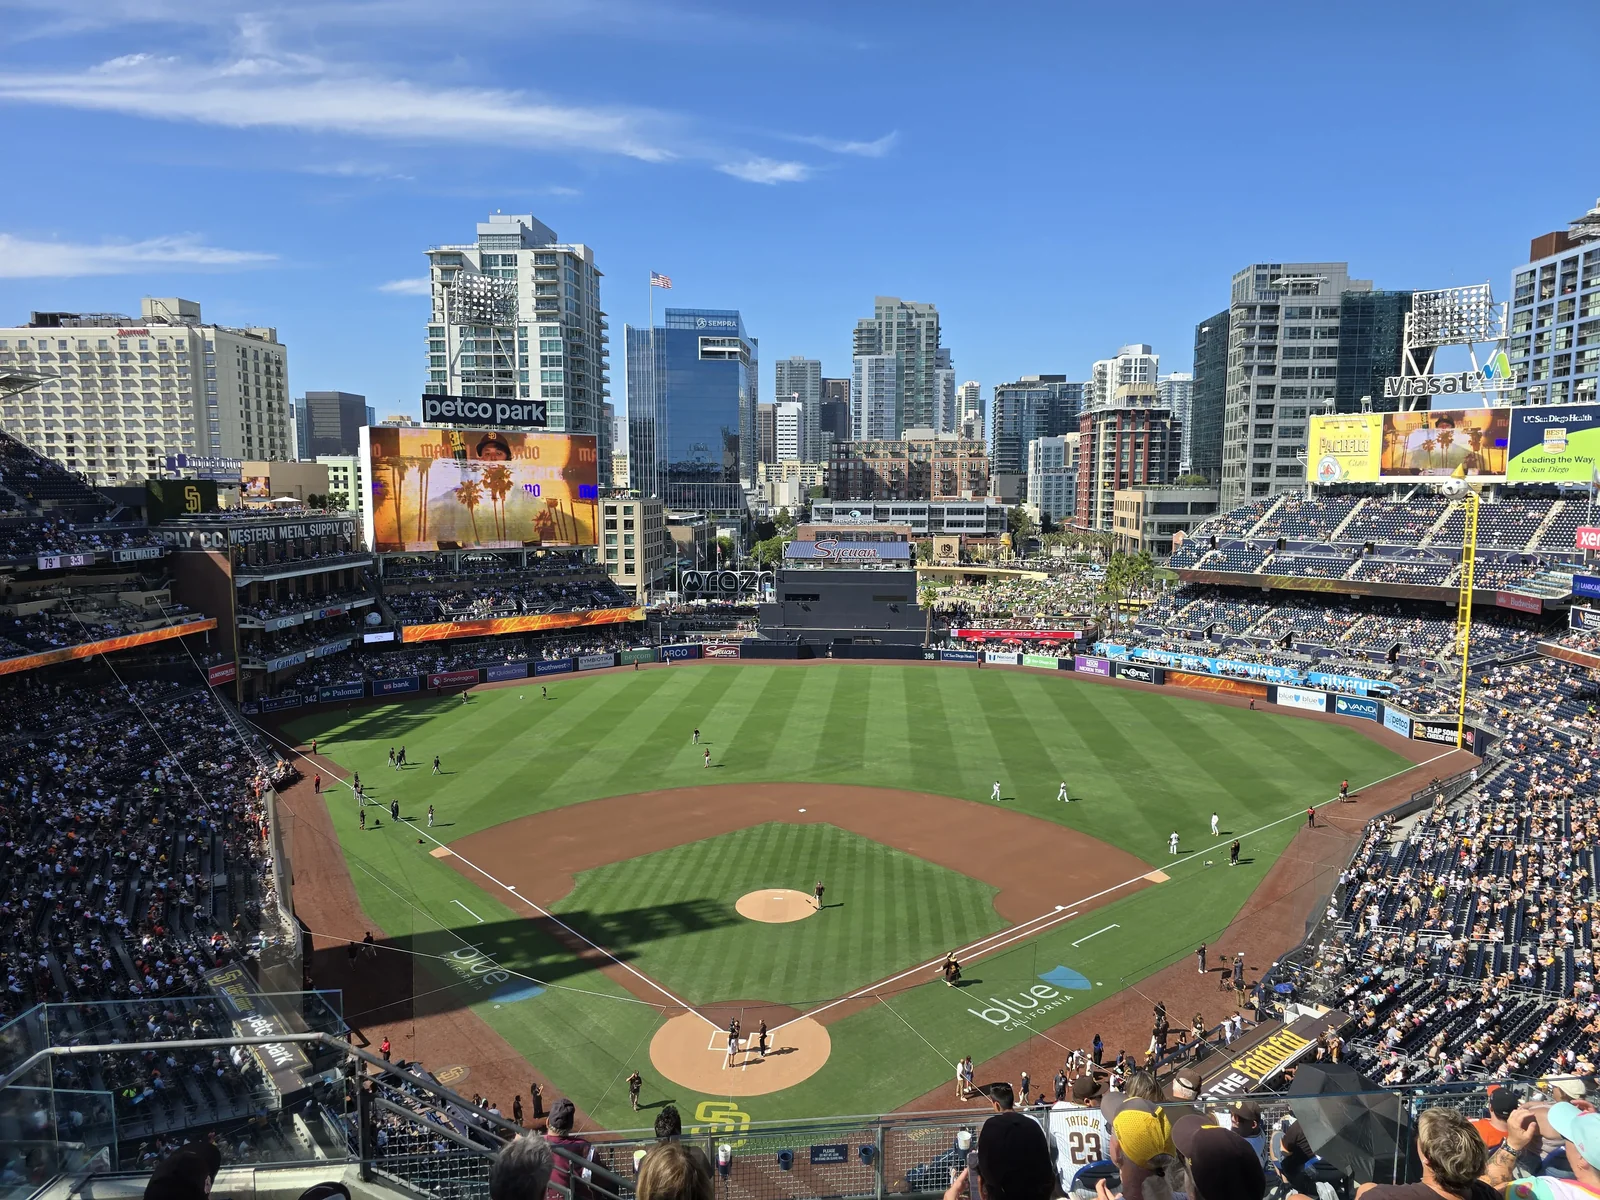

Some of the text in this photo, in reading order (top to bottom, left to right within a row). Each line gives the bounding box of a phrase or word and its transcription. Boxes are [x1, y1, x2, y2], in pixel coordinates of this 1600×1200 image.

[1388, 372, 1472, 396] Viasat
[425, 397, 545, 424] petco park
[1523, 413, 1592, 424] UC San Diego Health
[1521, 456, 1556, 464] Leading
[1574, 456, 1593, 464] Way
[1548, 466, 1569, 474] Diego
[229, 521, 356, 544] WESTERN METAL SUPPLY CO.
[120, 548, 160, 561] CUTWATER
[813, 539, 878, 563] Sycuan
[70, 555, 84, 566] 3:31
[706, 571, 774, 593] razr
[1511, 597, 1539, 610] Budweiser
[663, 649, 688, 658] ARCO
[705, 646, 737, 658] Sycuan
[924, 652, 935, 660] 396
[537, 663, 566, 672] Southwest
[242, 671, 252, 680] 330
[443, 674, 474, 684] Snapdragon
[392, 681, 409, 689] bank
[304, 694, 317, 704] 342
[332, 688, 362, 697] Palomar
[1392, 716, 1408, 729] petco
[450, 942, 509, 985] blue
[967, 985, 1060, 1025] blue
[1003, 994, 1074, 1032] CALIFORNIA
[258, 1042, 294, 1067] park
[1209, 1072, 1250, 1096] THE
[1065, 1115, 1089, 1128] TATIS
[1069, 1131, 1102, 1165] 23
